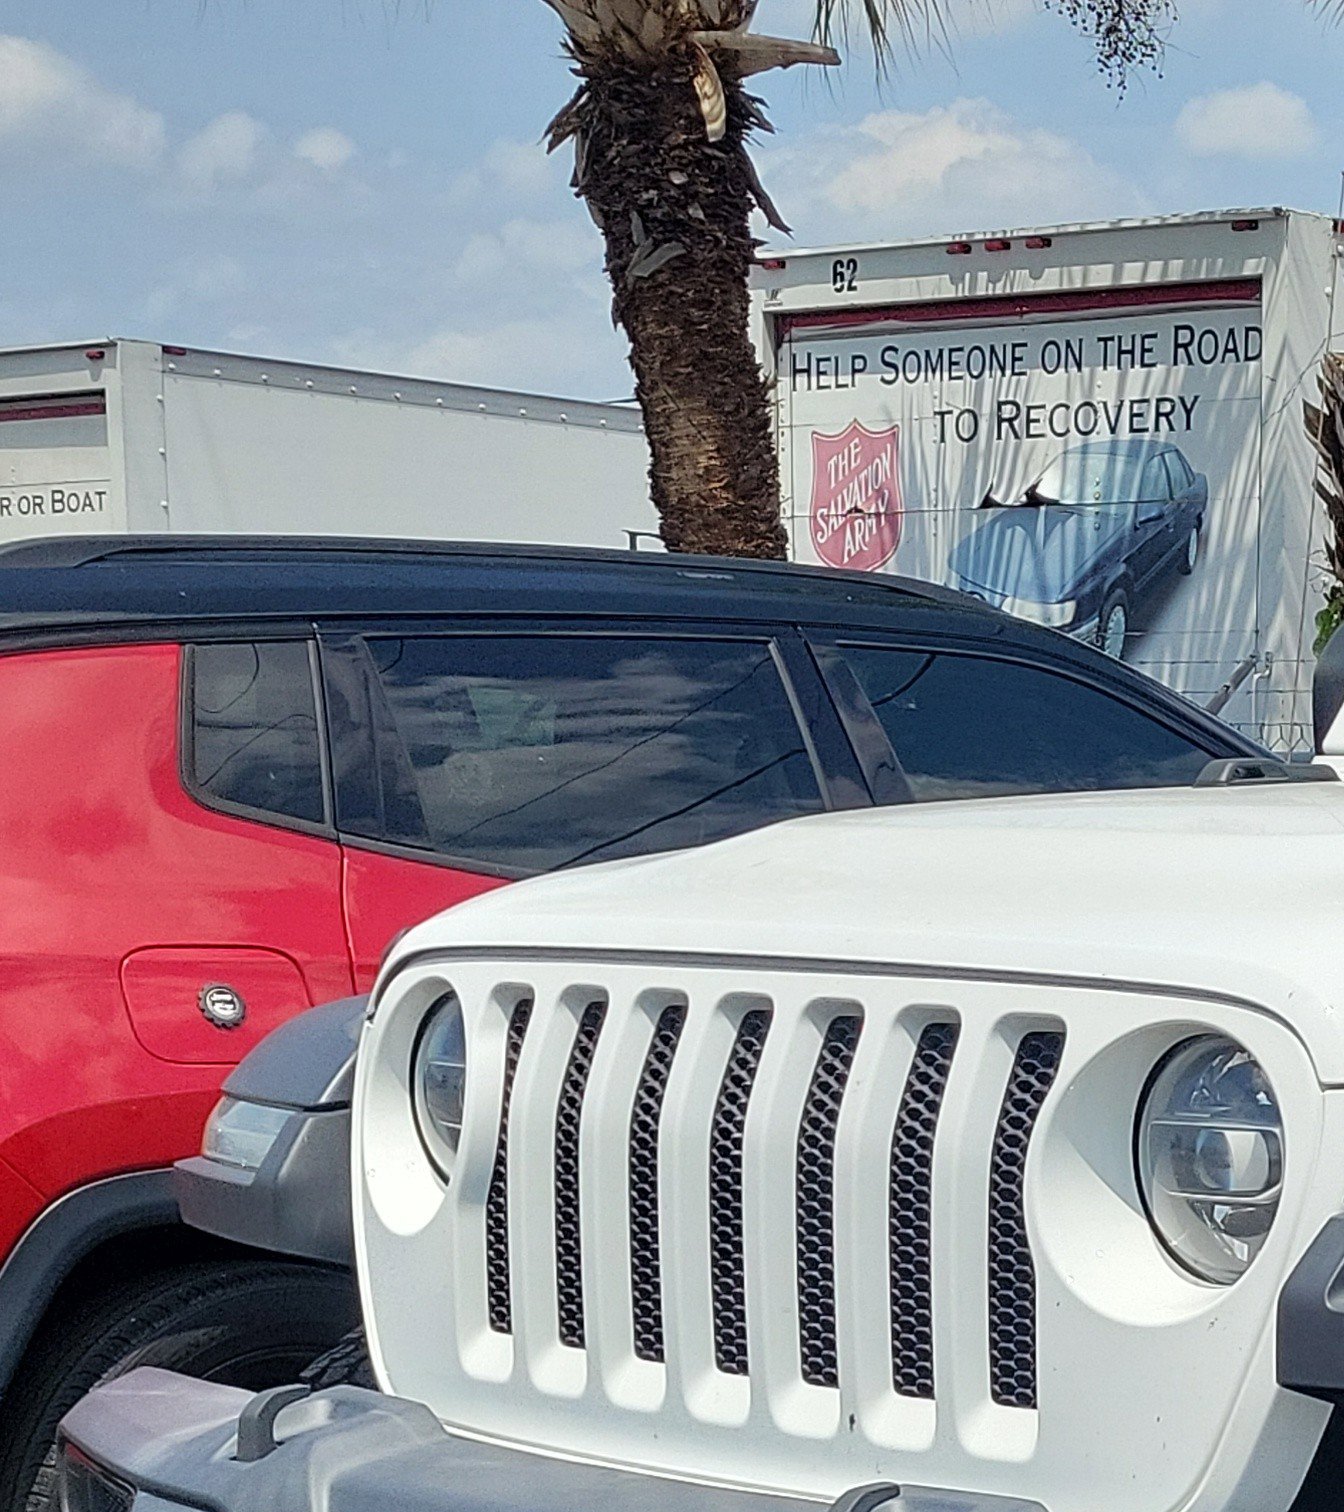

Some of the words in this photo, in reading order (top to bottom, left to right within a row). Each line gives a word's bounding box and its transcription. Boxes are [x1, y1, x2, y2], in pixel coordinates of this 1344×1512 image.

[832, 258, 858, 293] 62
[792, 351, 868, 391] HELP
[880, 342, 1028, 386] SOMEONE
[1041, 338, 1083, 374] ON
[1097, 333, 1159, 371] THE
[1172, 324, 1262, 366] ROAD
[933, 408, 979, 443] TO
[996, 395, 1201, 441] RECOVERY
[827, 437, 862, 490] THE
[18, 495, 45, 515] OR
[51, 489, 107, 513] BOAT
[816, 443, 892, 544] SALVATION
[842, 490, 889, 566] ARMY
